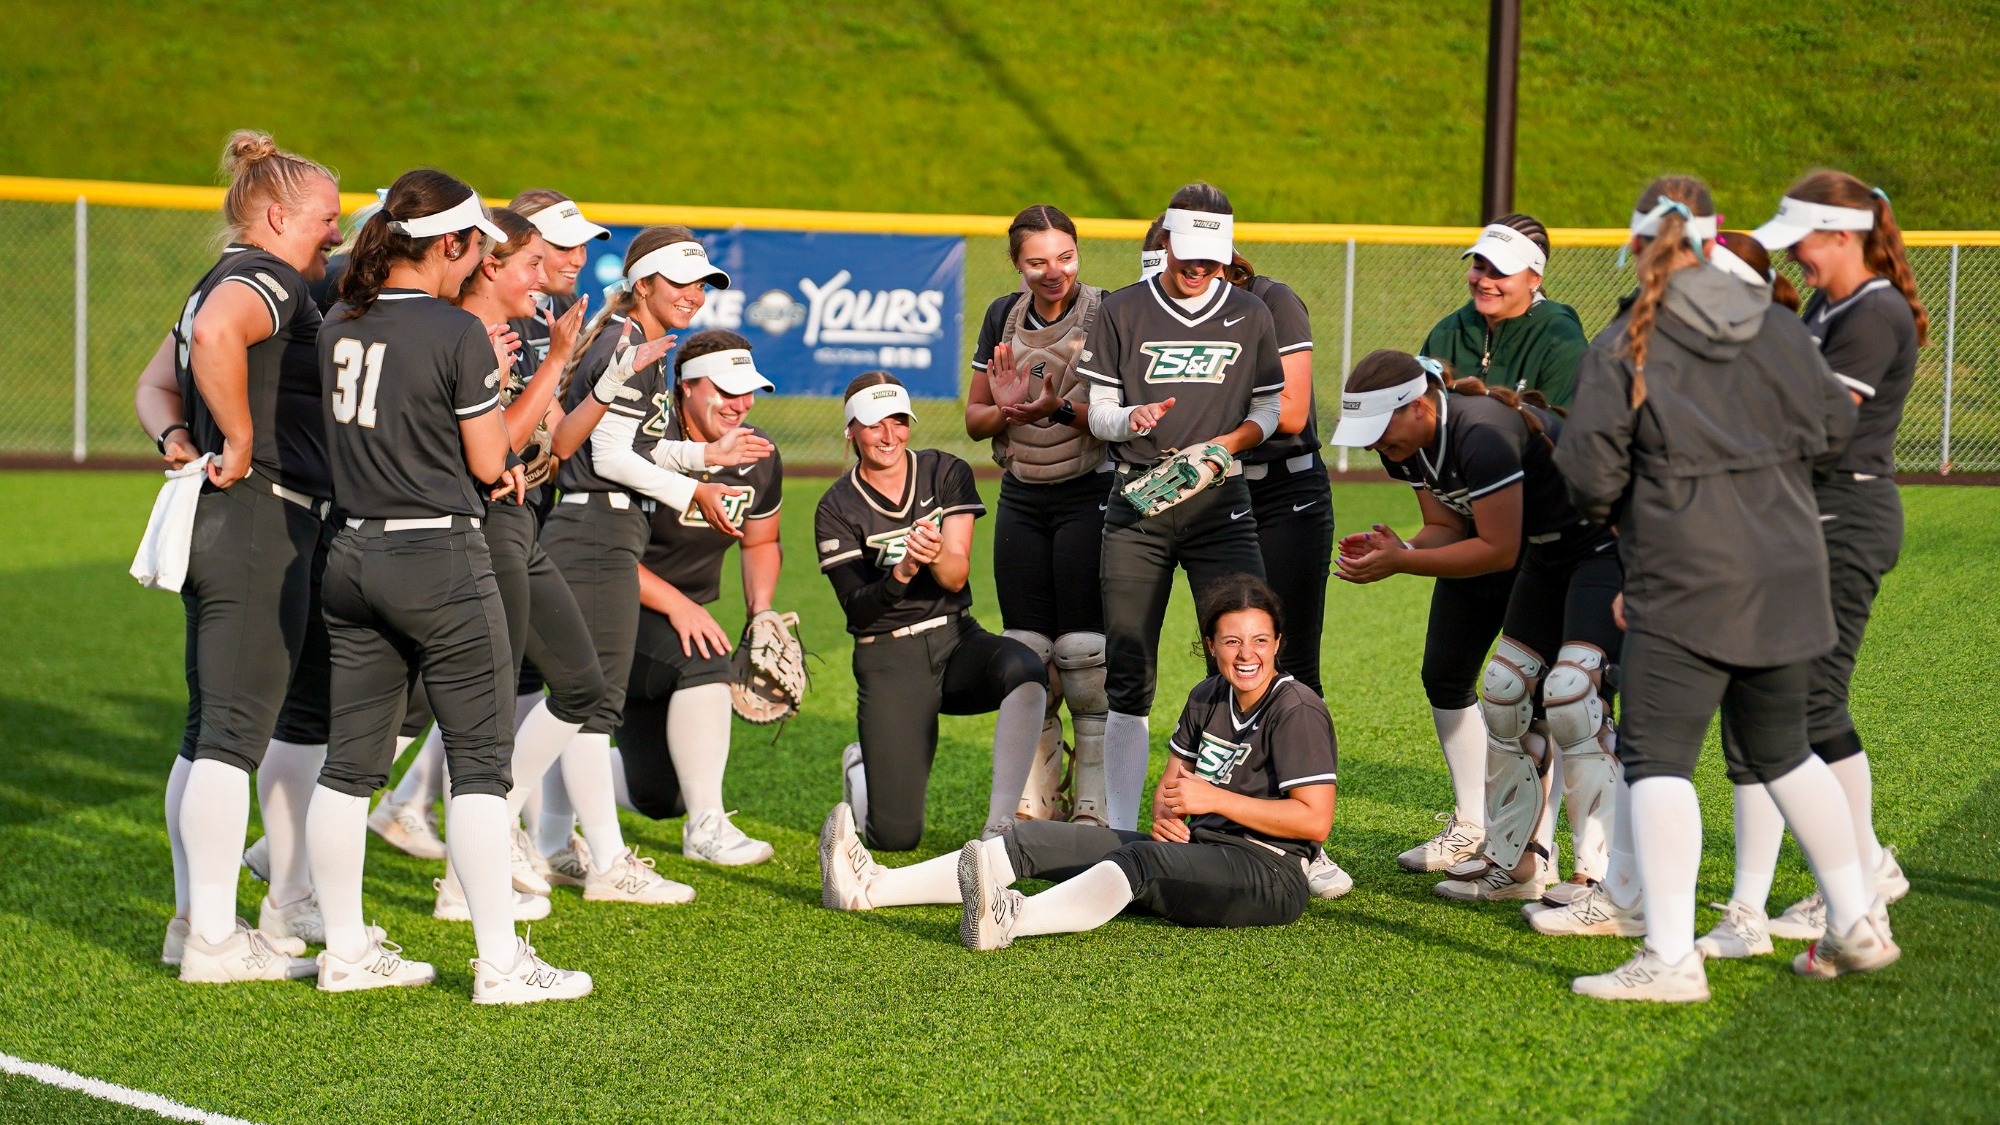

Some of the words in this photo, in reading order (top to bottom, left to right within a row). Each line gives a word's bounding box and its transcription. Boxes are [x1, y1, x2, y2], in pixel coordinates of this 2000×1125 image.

[1193, 219, 1221, 230] MINERS
[799, 268, 944, 347] YOURS
[1147, 344, 1238, 380] S&T
[332, 337, 388, 429] 31
[524, 463, 549, 483] Wilson
